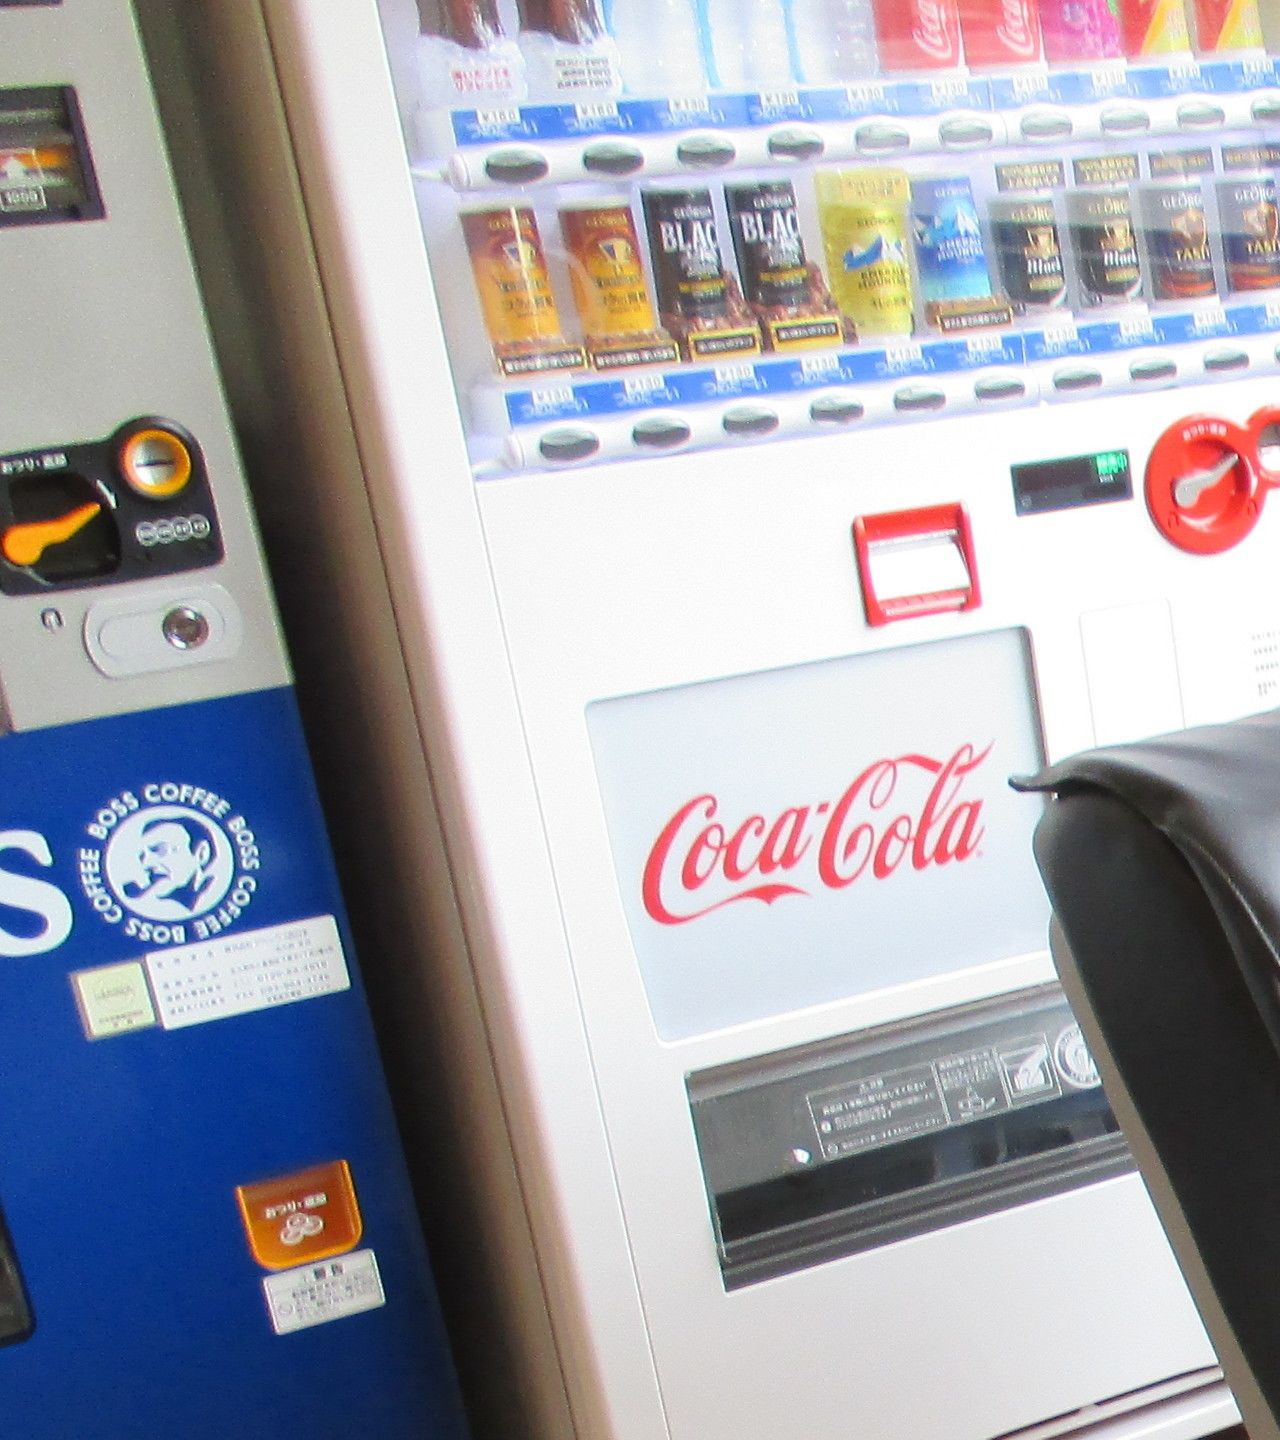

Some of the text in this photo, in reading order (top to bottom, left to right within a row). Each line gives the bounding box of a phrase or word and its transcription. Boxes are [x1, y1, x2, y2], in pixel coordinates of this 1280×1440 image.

[78, 782, 260, 944] BOSS COFFEE BOSS COFFEE BOSS COFFEE
[642, 737, 995, 926] Coca-Cola
